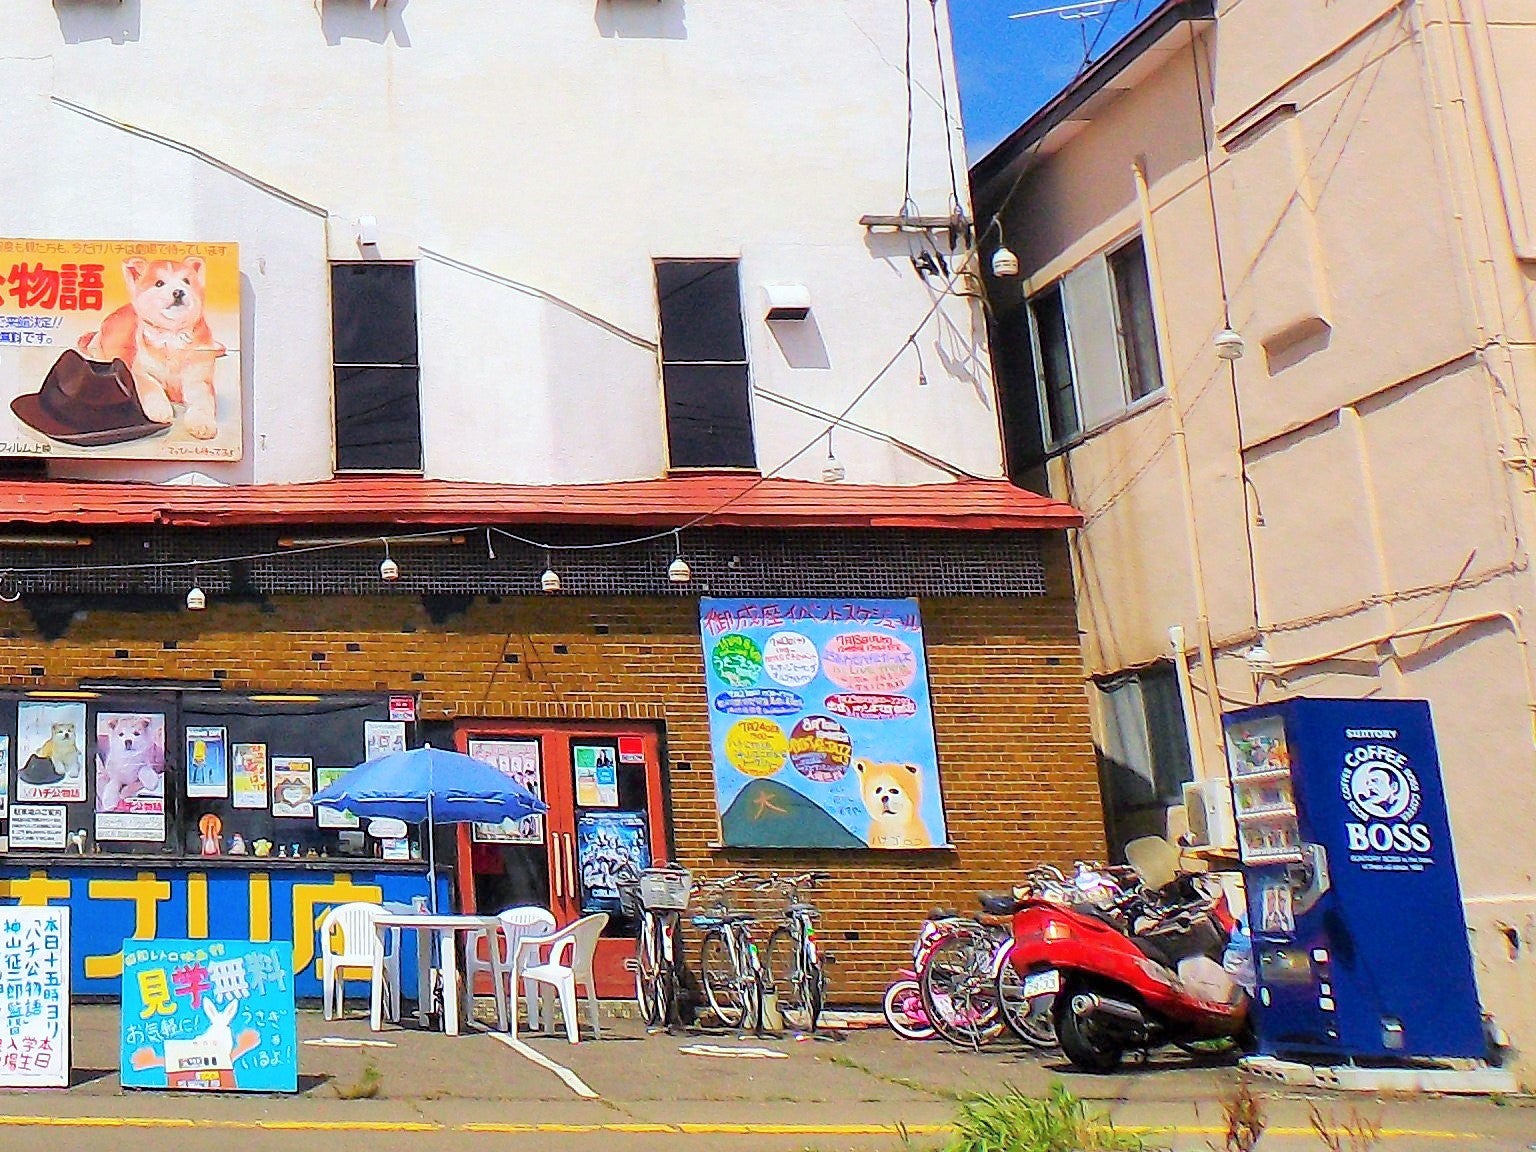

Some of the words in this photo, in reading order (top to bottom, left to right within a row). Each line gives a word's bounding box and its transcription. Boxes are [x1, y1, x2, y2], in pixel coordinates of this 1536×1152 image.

[1345, 745, 1408, 769] COFFEE
[1345, 822, 1432, 852] BOSS
[137, 947, 287, 1019] 見学無料
